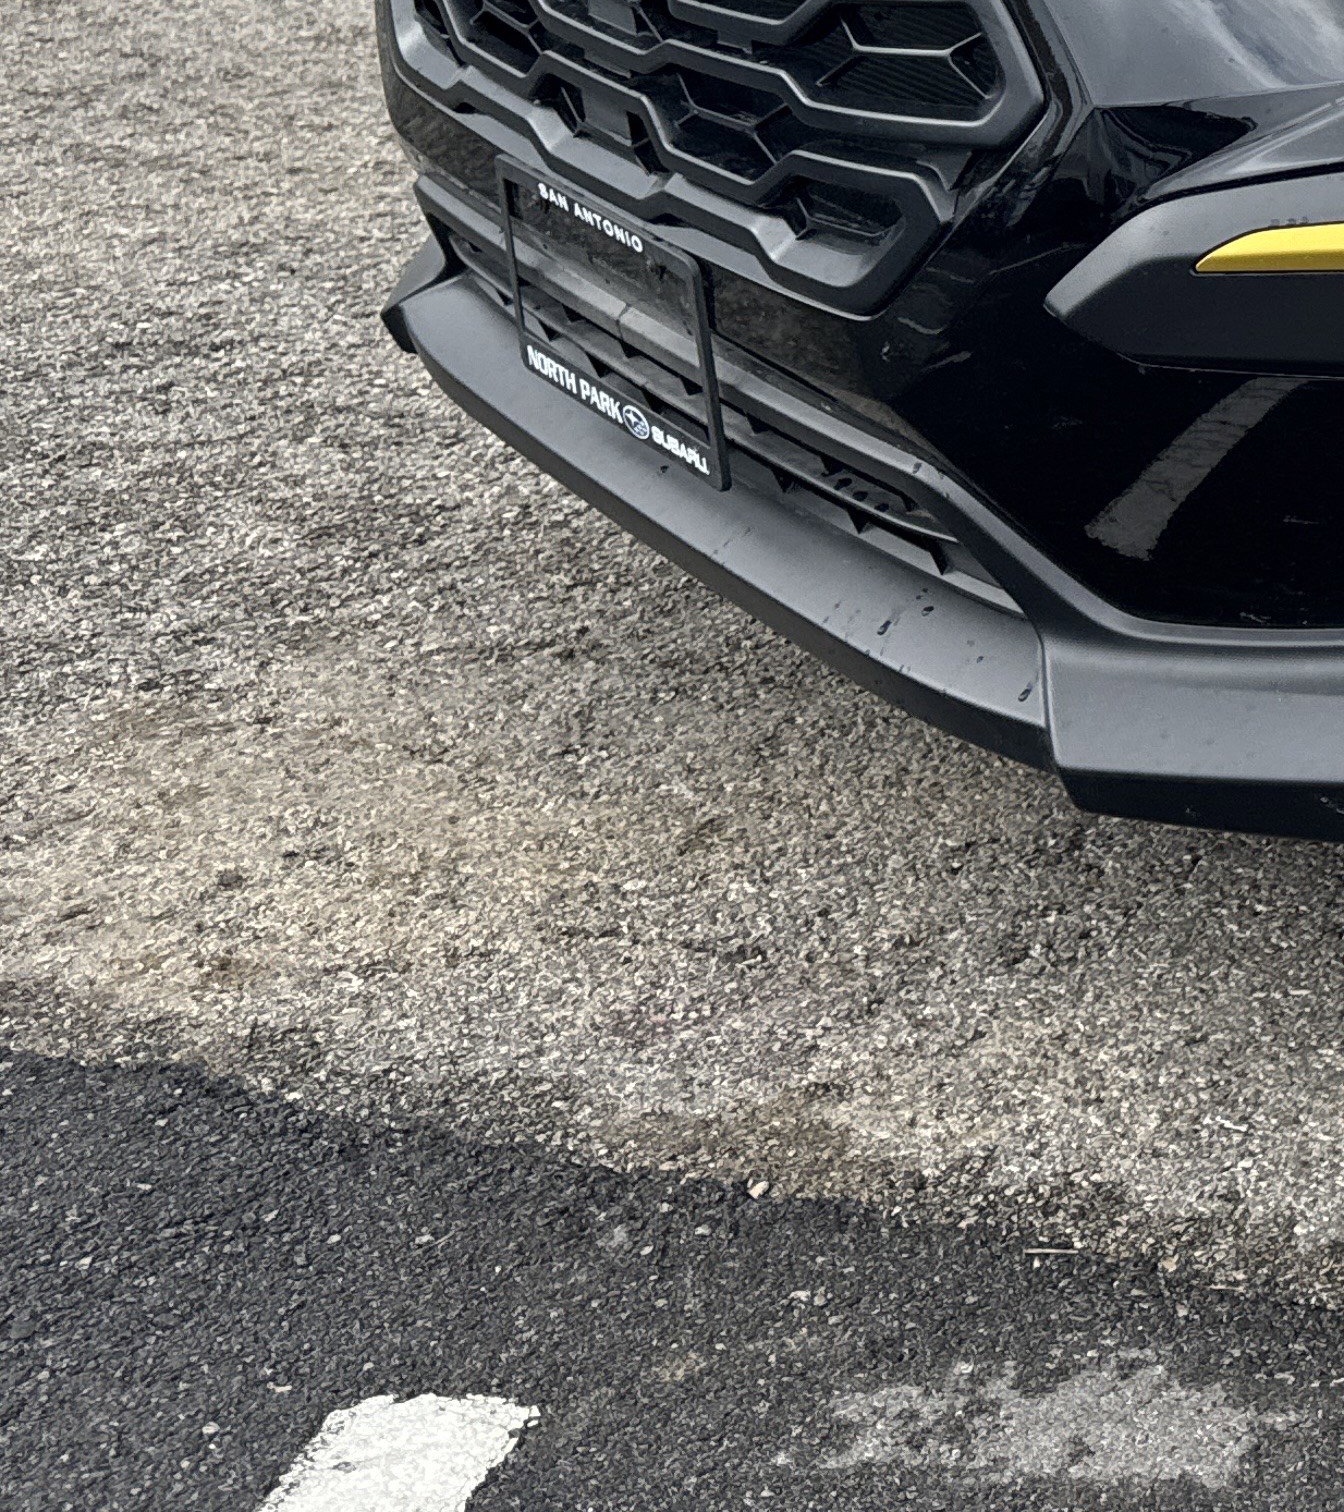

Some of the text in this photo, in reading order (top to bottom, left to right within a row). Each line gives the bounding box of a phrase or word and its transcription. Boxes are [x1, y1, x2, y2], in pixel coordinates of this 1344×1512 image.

[537, 182, 643, 254] SAN ANTONIO
[526, 344, 711, 476] NORTH PARK SUBARU
